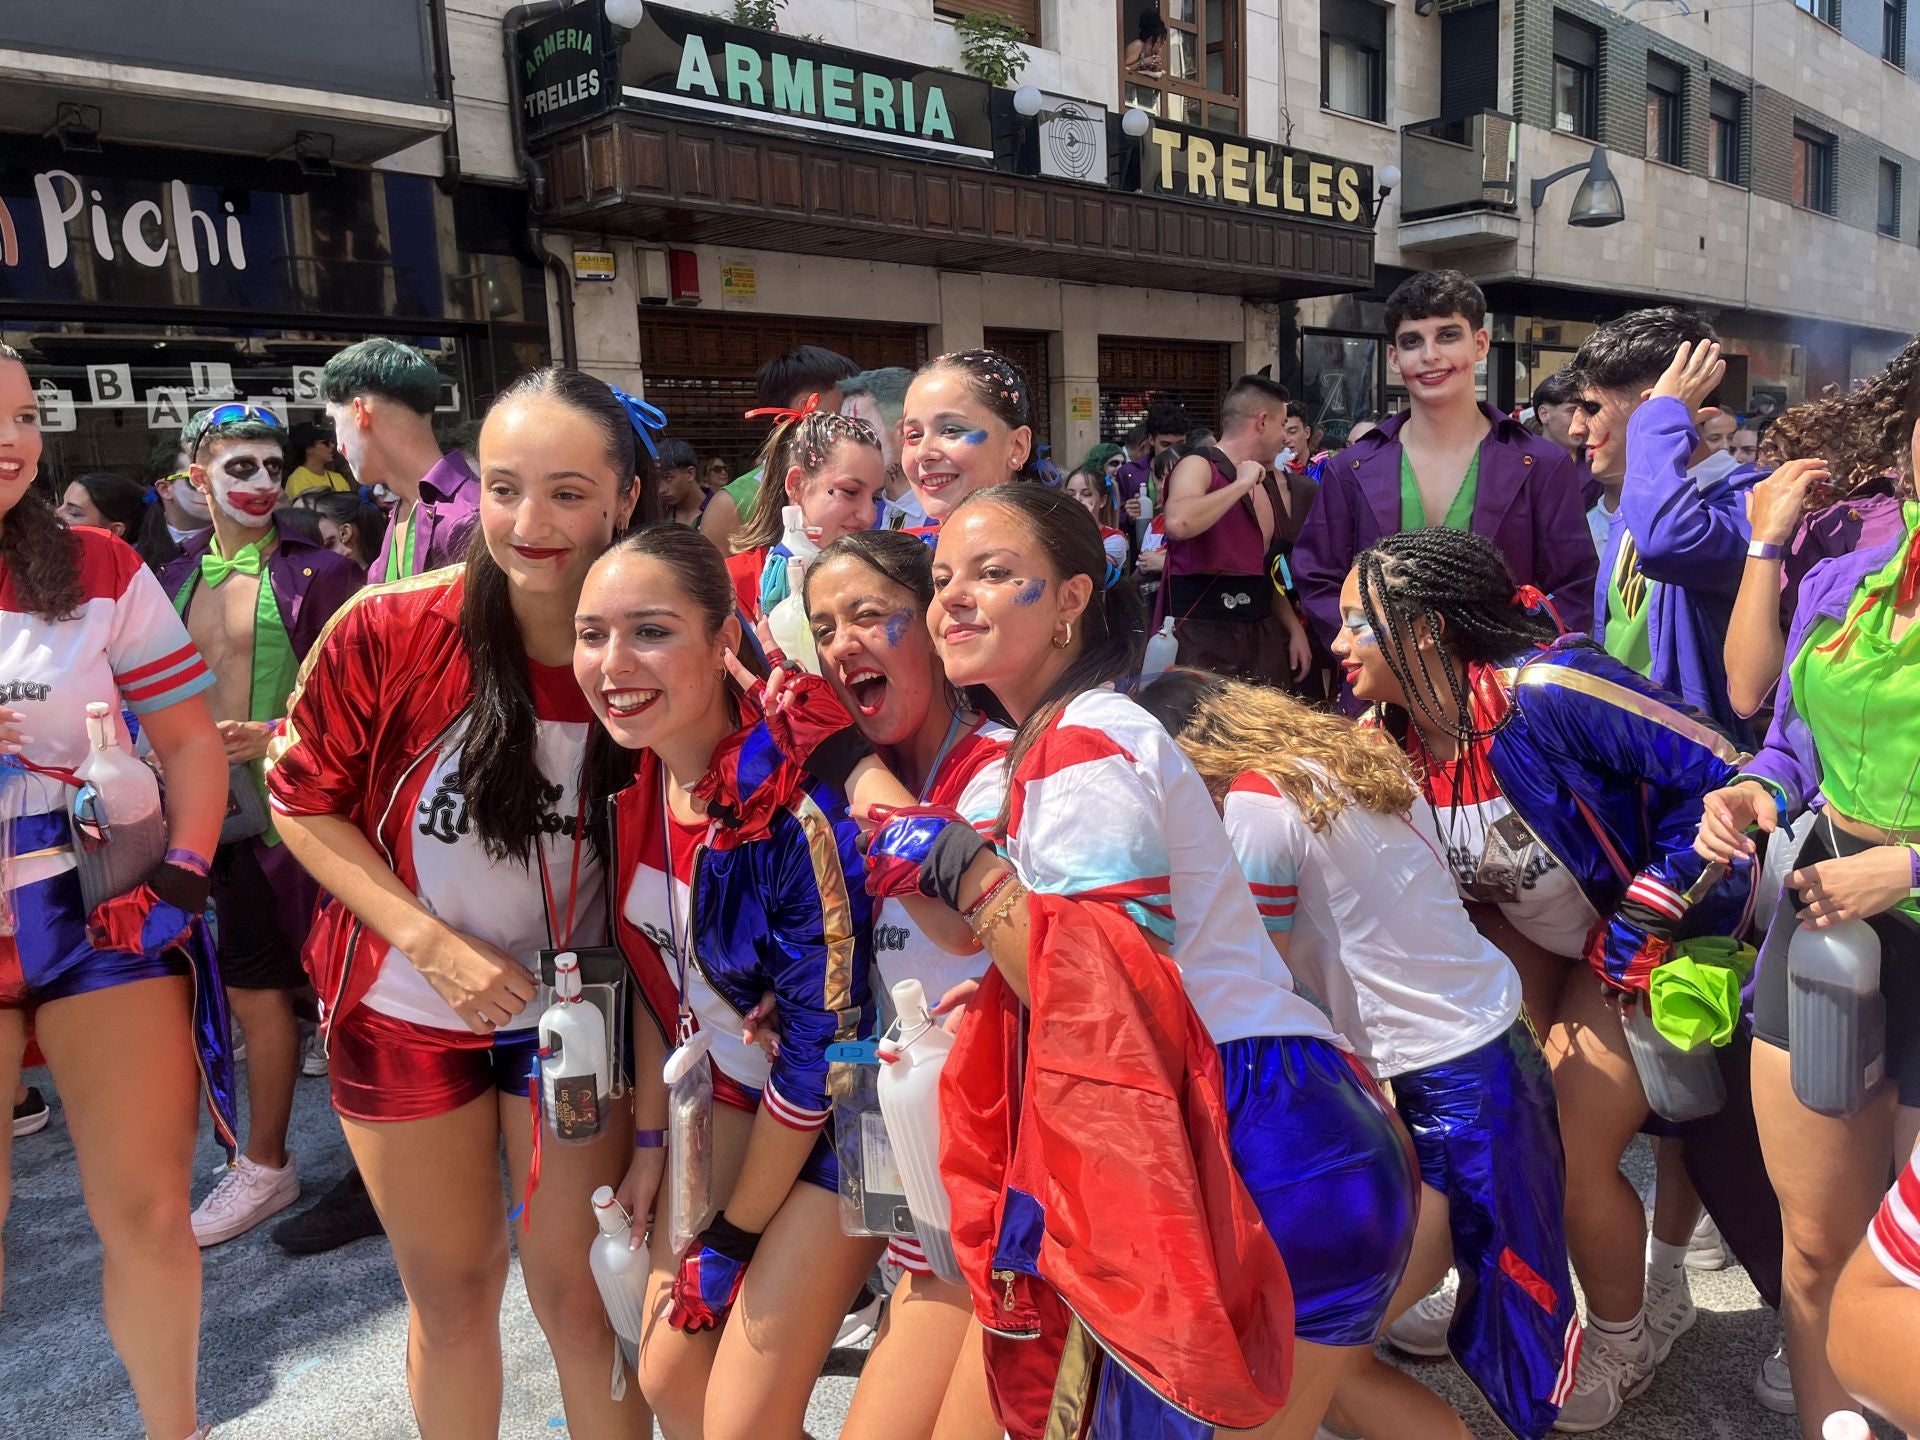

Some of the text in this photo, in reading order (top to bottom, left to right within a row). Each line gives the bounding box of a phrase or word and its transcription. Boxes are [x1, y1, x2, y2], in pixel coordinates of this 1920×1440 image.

[524, 68, 600, 117] TRELLES
[526, 28, 592, 79] ARMERIA
[676, 33, 954, 139] ARMERIA
[34, 169, 247, 273] Pichi
[1152, 127, 1360, 222] TRELLES
